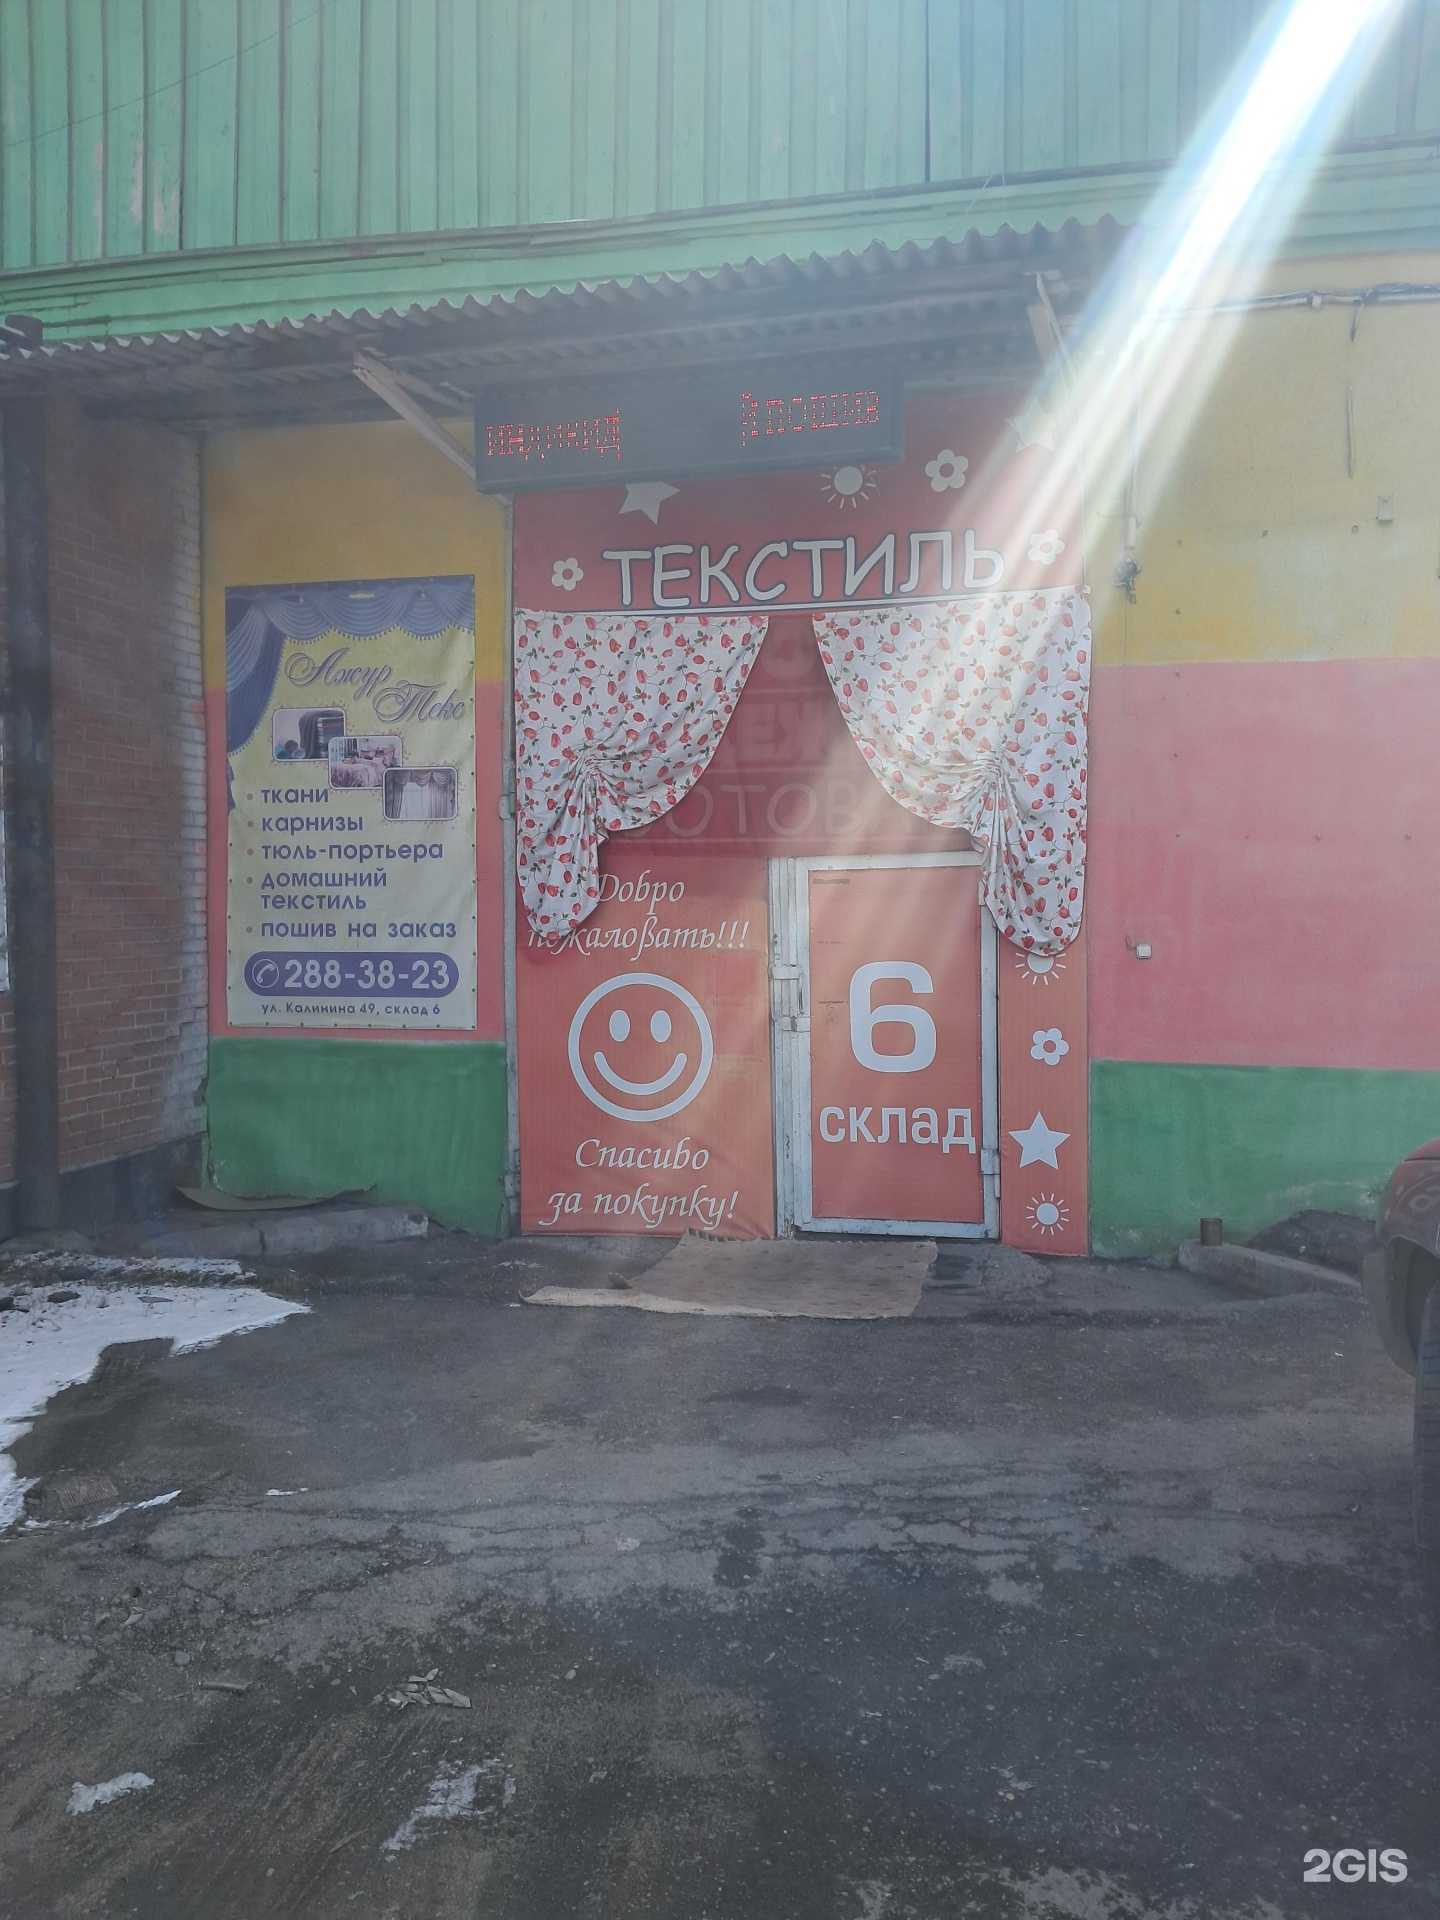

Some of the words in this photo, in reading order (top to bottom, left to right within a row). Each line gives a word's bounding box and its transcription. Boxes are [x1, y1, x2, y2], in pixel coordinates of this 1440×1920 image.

[603, 529, 1006, 608] ТЕКСТИЛЬ
[284, 647, 392, 701] Ажур
[260, 787, 329, 804] ткани
[261, 816, 363, 836] карнизы
[261, 843, 443, 863] тюль-портьера
[260, 867, 387, 890] домашний
[599, 869, 685, 916] Добро
[260, 894, 367, 910] текстиль
[261, 921, 337, 938] пошив
[348, 922, 377, 938] на
[388, 922, 457, 939] заказ
[284, 959, 450, 989] 288-38-23
[261, 1003, 282, 1015] ул.
[286, 1002, 355, 1014] Калинина
[360, 1003, 380, 1016] 49,
[385, 1003, 429, 1016] склад
[432, 1003, 441, 1015] 6
[849, 960, 937, 1073] 6
[819, 1106, 977, 1154] склад
[575, 1136, 710, 1170] Спасибо
[538, 1191, 583, 1226] за
[594, 1183, 739, 1231] покупку!
